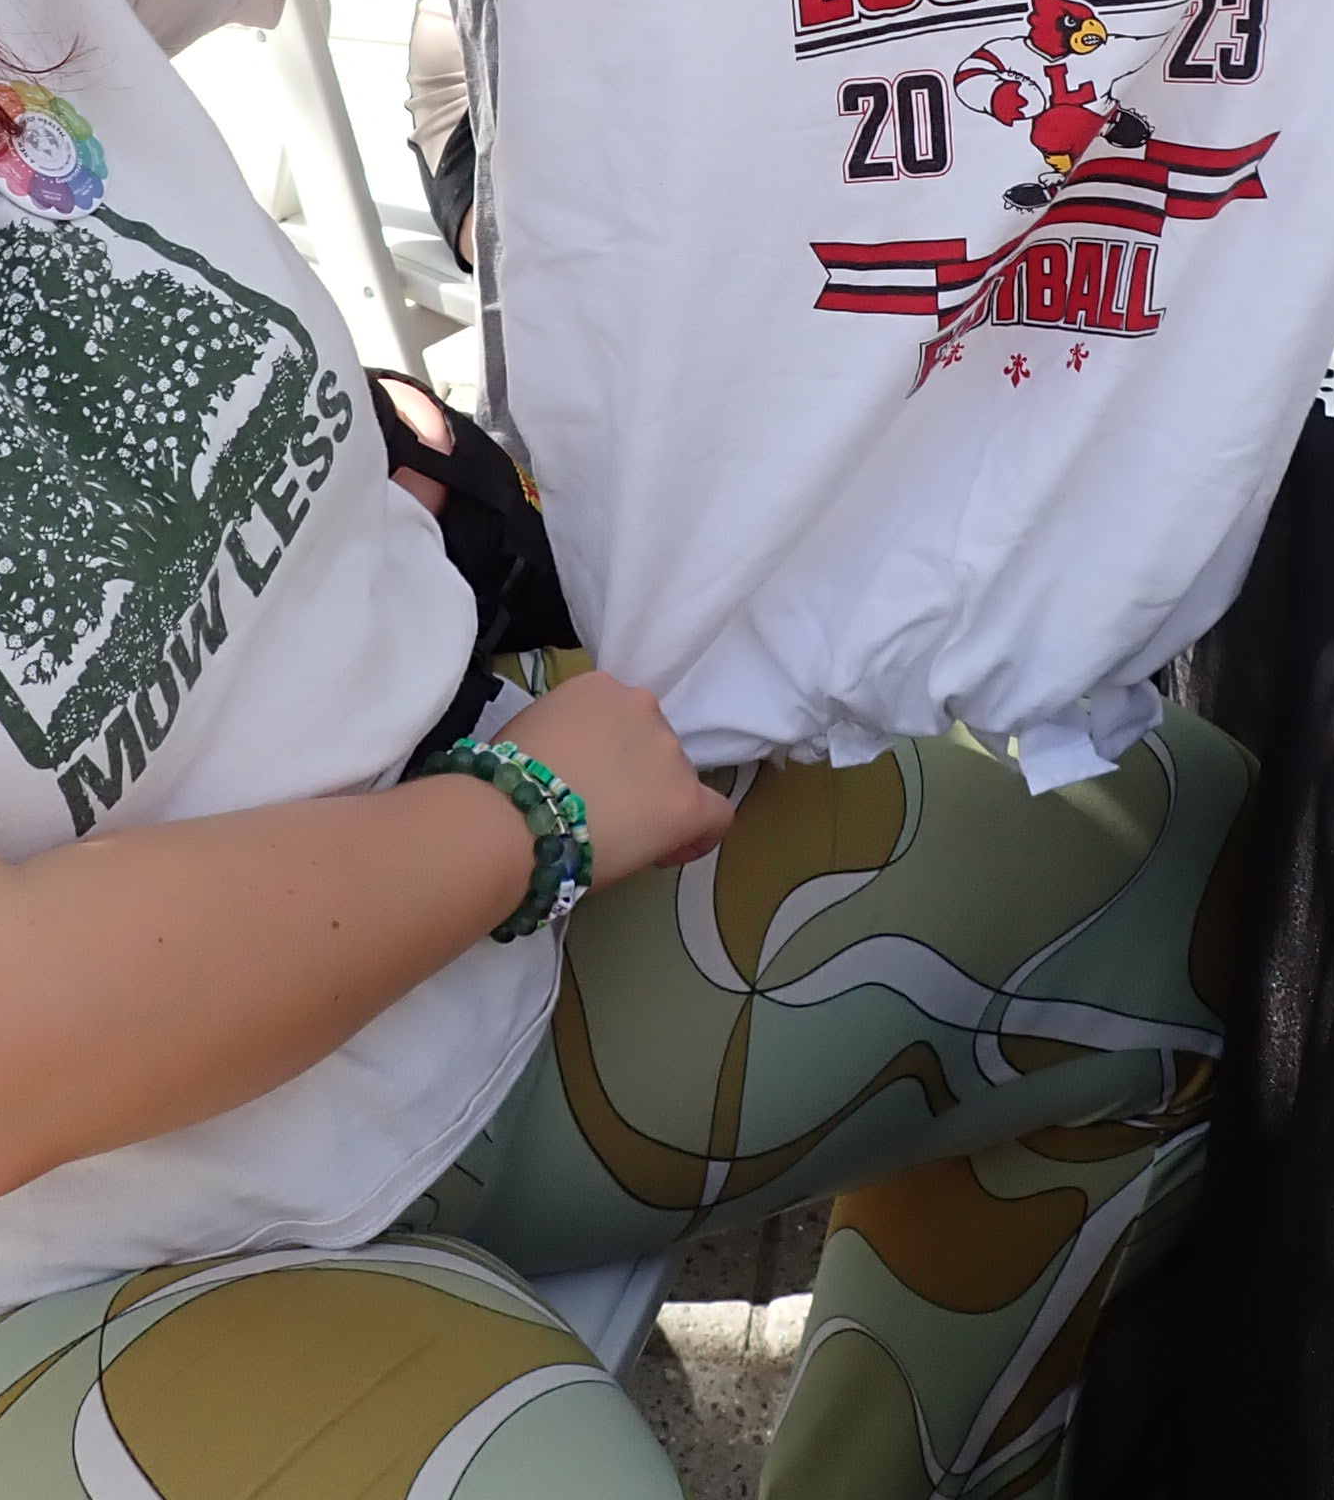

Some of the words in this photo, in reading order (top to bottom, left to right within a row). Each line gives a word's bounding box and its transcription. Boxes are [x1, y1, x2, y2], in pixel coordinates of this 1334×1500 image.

[838, 70, 953, 184] 20
[907, 237, 1166, 398] FTBALL
[57, 569, 229, 838] MOW
[224, 369, 354, 598] LESS
